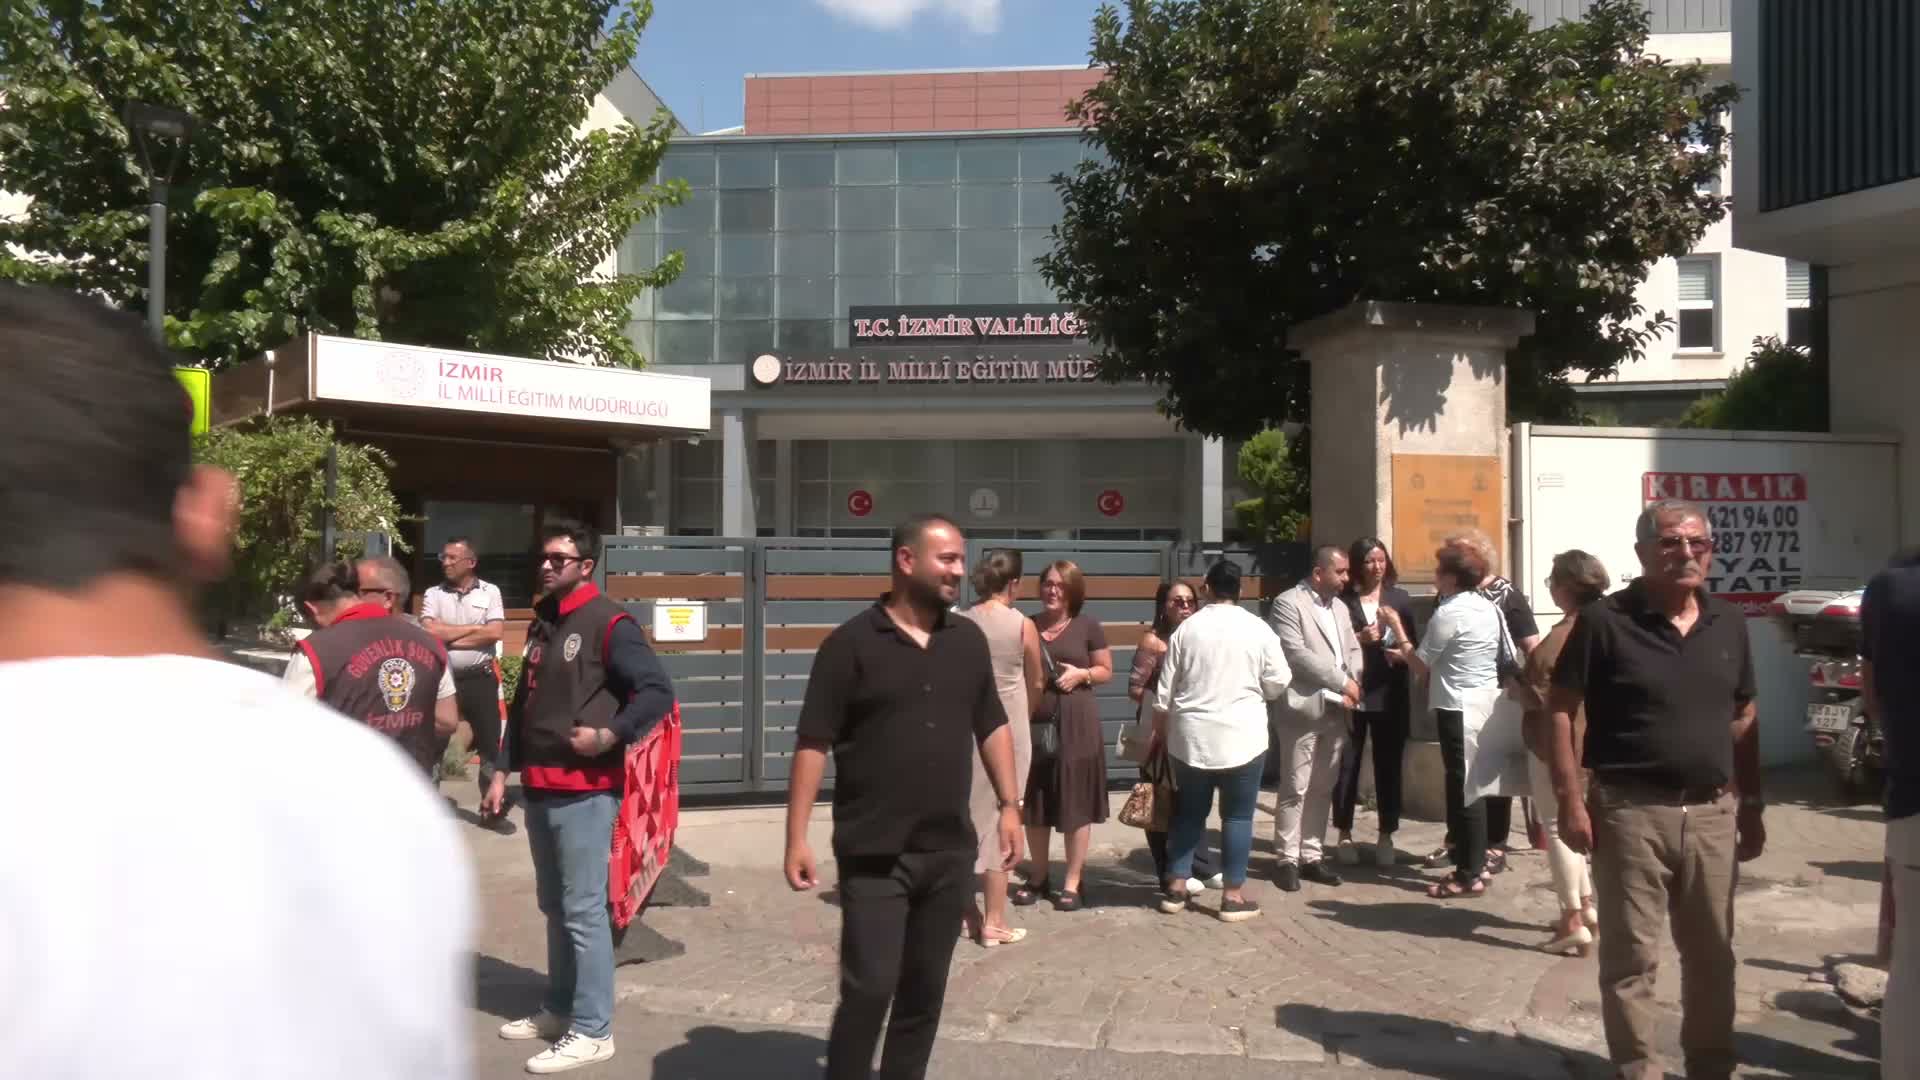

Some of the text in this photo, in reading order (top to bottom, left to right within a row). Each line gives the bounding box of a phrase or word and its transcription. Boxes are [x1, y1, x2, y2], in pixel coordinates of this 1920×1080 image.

[854, 318, 895, 337] T.C.
[898, 314, 974, 337] İZMİR
[438, 359, 504, 383] İZMİR
[784, 355, 853, 381] İZMİR
[859, 355, 881, 381] İL
[955, 354, 1040, 380] EĞİTİM
[438, 381, 452, 400] İL
